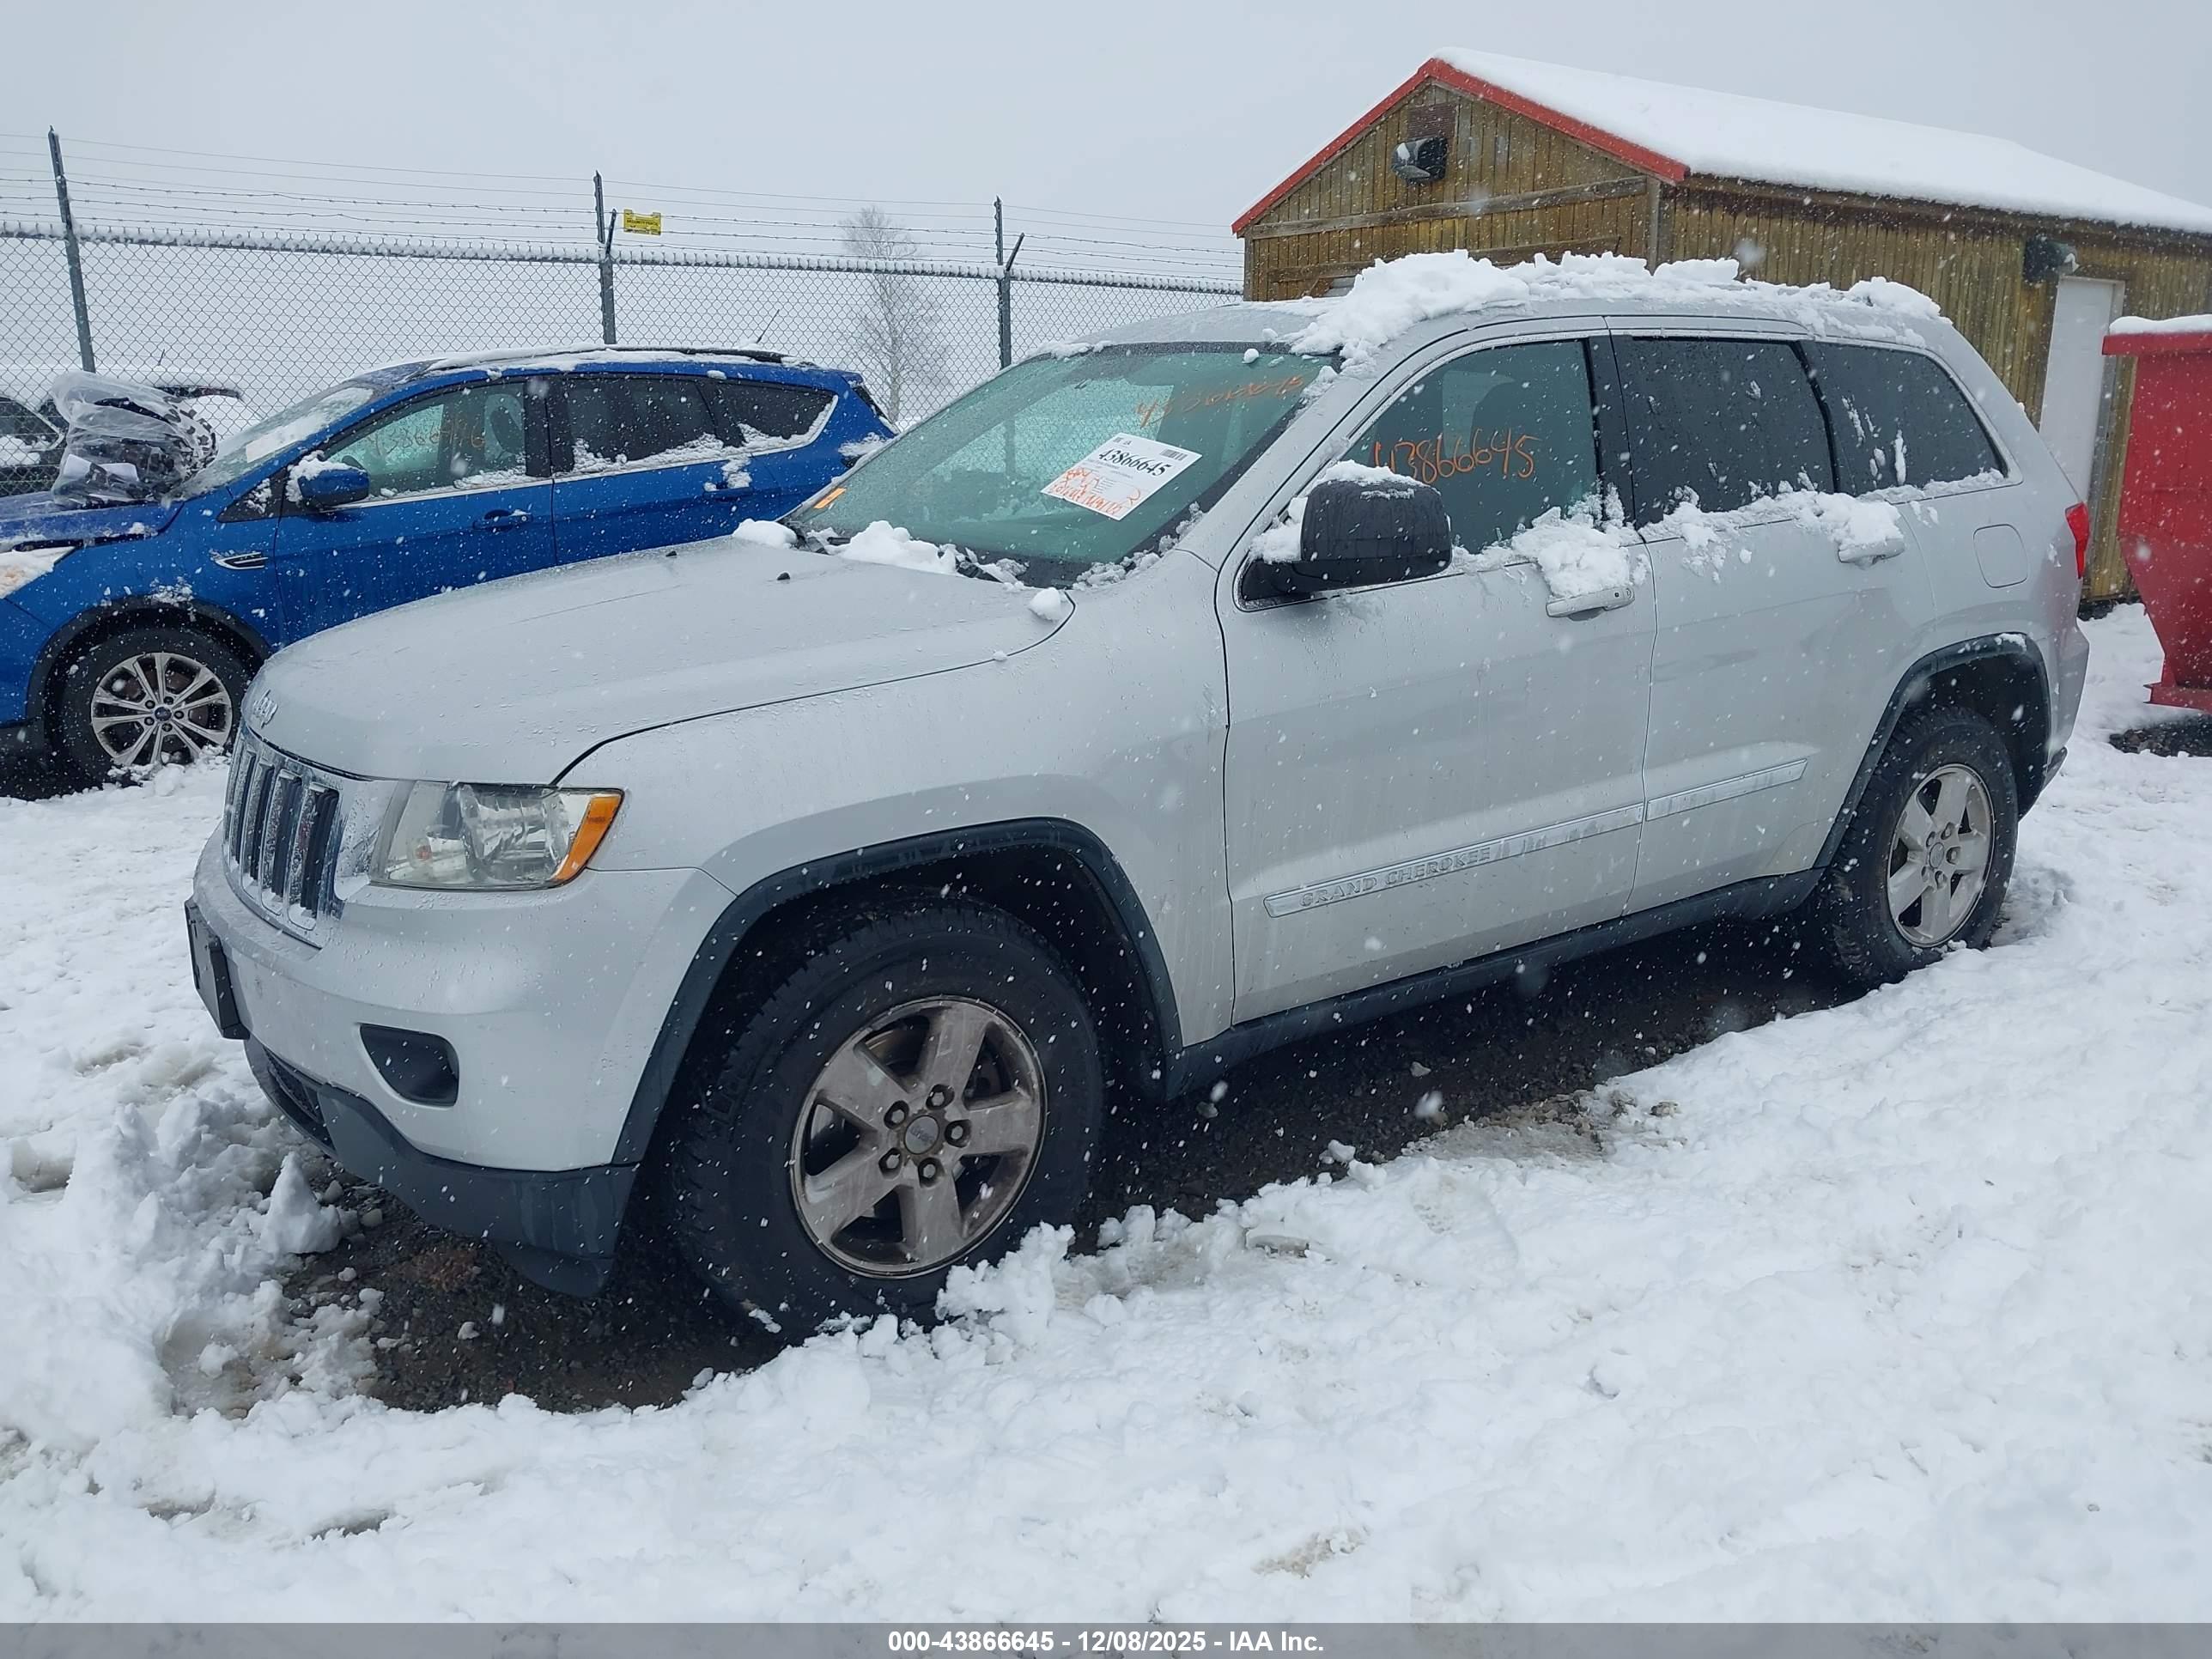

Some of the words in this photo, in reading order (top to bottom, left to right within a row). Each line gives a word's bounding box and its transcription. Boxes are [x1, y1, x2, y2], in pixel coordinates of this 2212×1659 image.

[1099, 448, 1172, 477] 43866645
[1374, 428, 1543, 484] 43866645
[1299, 877, 1377, 907] GRAND
[1385, 847, 1492, 886] CHEROKEE
